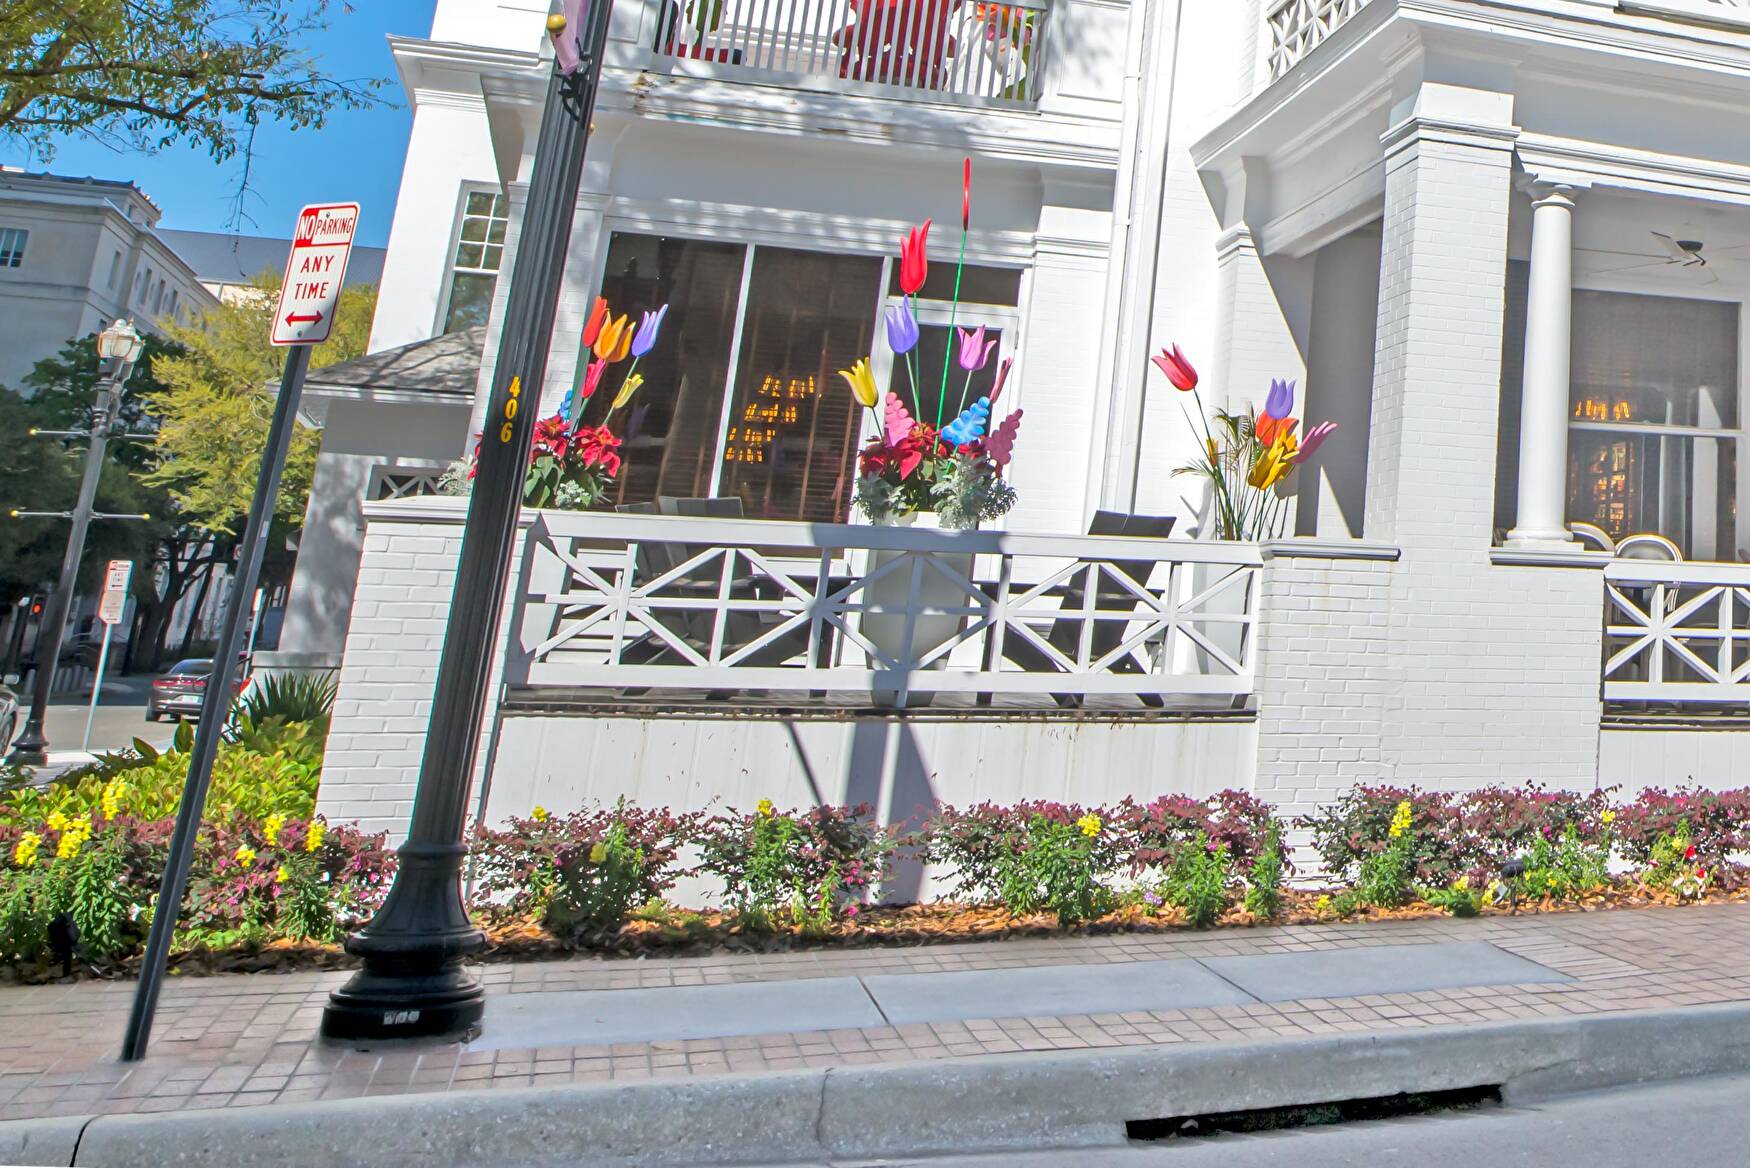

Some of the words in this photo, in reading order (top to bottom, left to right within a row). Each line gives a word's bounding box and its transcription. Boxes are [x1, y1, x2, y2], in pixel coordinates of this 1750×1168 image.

[297, 215, 316, 240] NO
[316, 217, 353, 235] PARKING
[300, 256, 334, 273] ANY
[295, 282, 328, 299] TIME
[500, 376, 520, 443] 406
